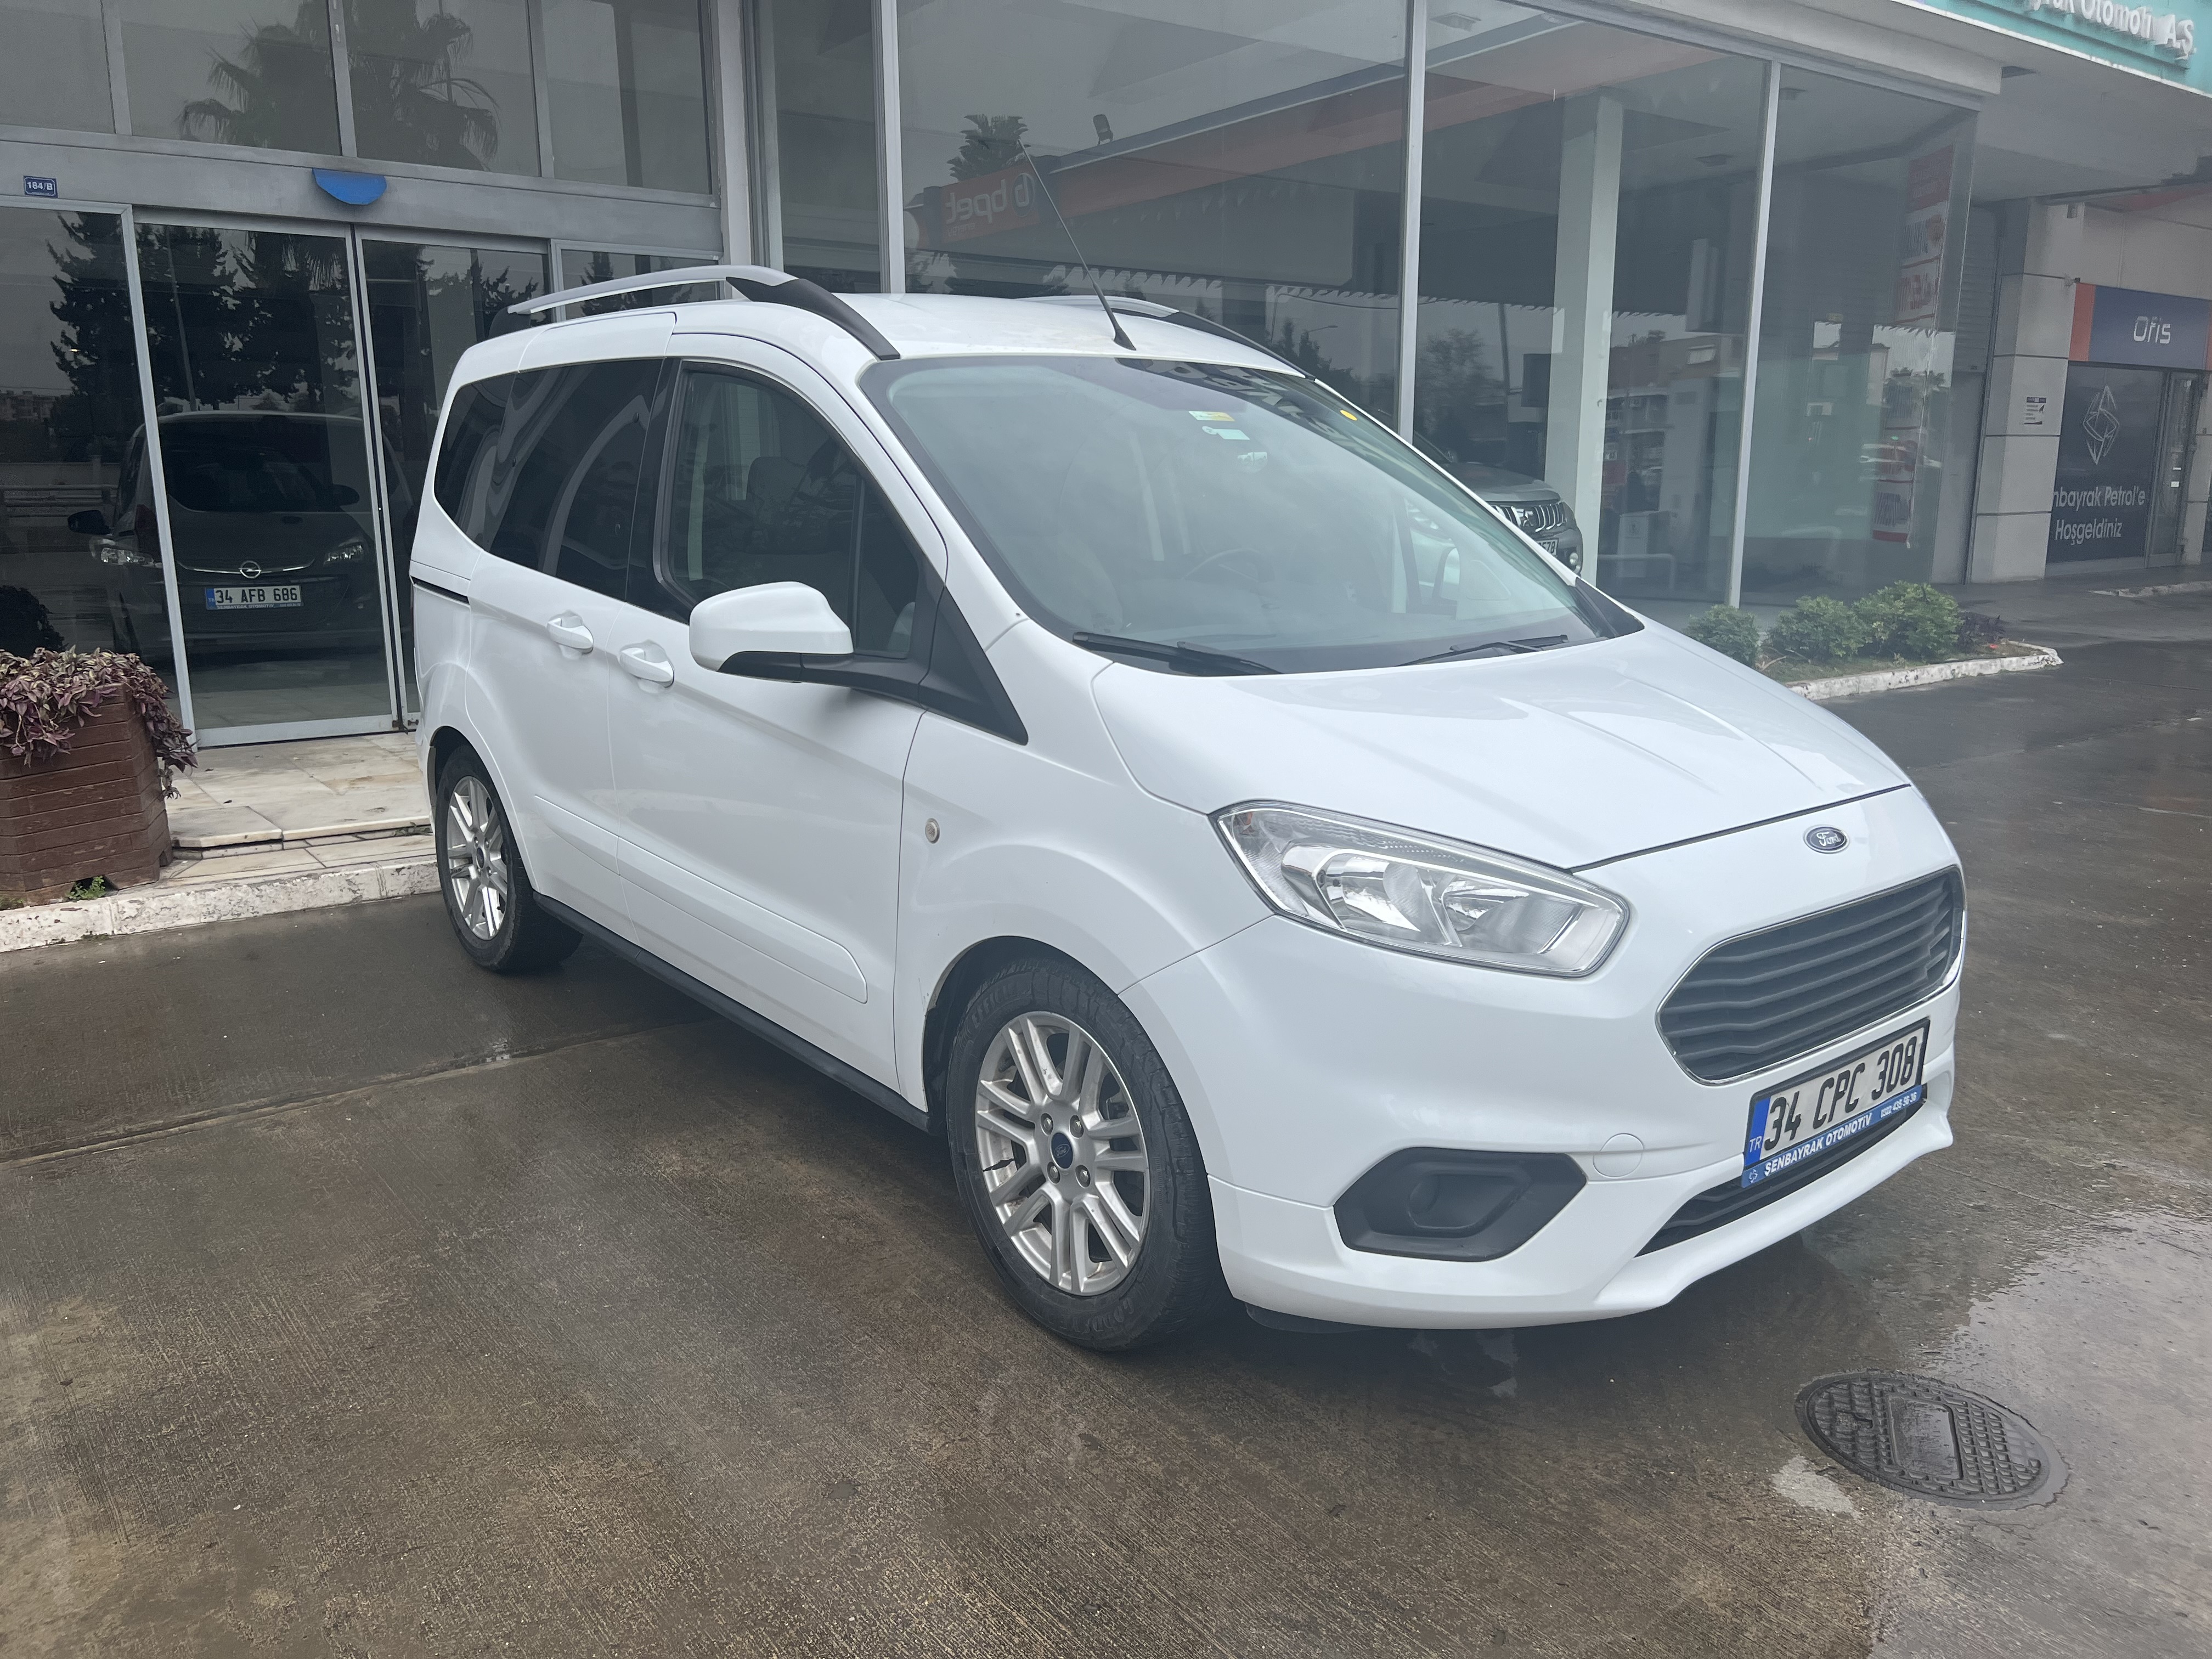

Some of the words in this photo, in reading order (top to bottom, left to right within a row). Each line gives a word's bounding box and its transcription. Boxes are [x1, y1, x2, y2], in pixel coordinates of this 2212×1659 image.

[27, 182, 53, 190] 184/B
[2134, 316, 2171, 344] Ofis
[2054, 518, 2123, 545] Hoşgeldiniz
[216, 590, 233, 603] 34
[241, 589, 266, 602] AFB
[273, 588, 298, 601] 686
[1816, 831, 1842, 846] Ford
[1764, 1091, 1802, 1151] 34
[1813, 1062, 1865, 1129] CPC
[1871, 1036, 1917, 1101] 308
[1750, 1136, 1762, 1153] TR
